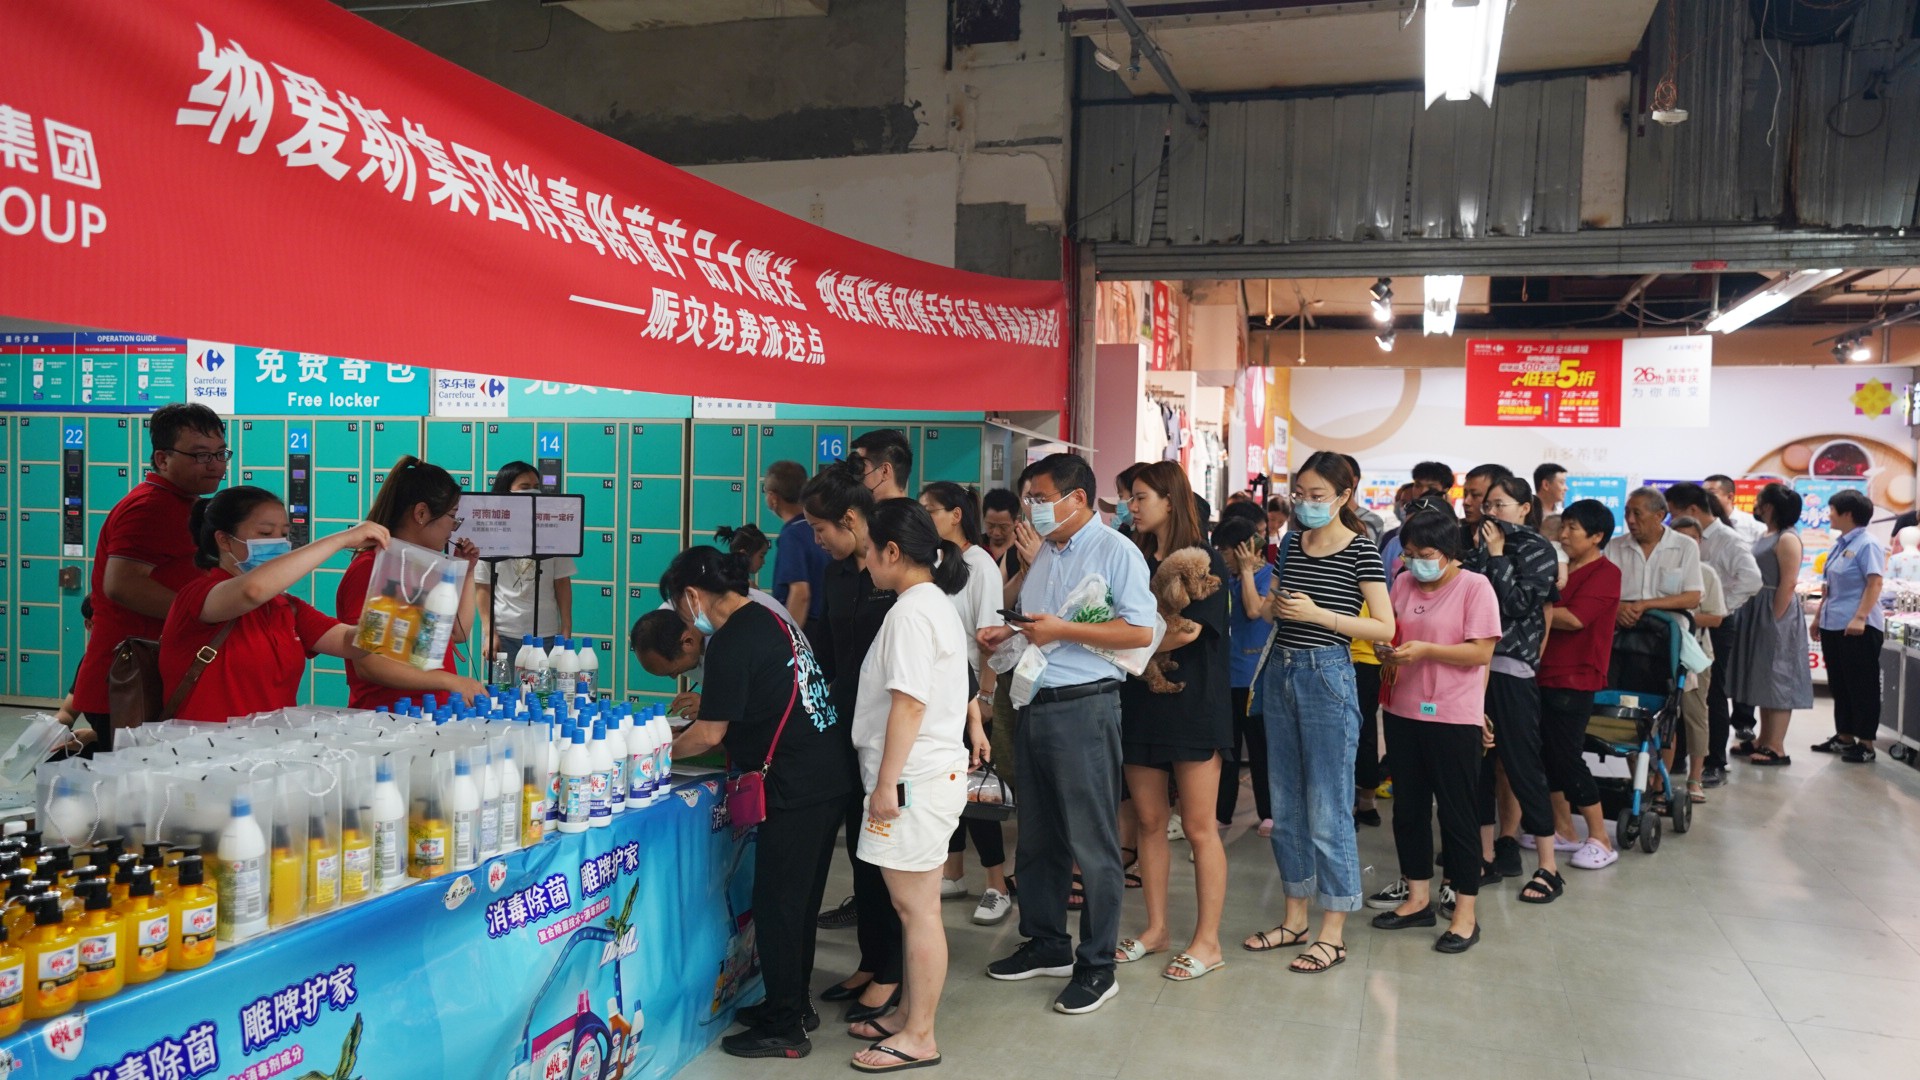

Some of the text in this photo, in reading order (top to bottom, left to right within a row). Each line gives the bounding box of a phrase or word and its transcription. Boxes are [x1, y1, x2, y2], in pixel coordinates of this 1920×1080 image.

[176, 22, 807, 311] 纳爱斯集团消毒除菌产品大赠送
[97, 335, 134, 343] OPERATION
[193, 376, 227, 385] Carrefour
[438, 378, 476, 389] 家乐福
[193, 386, 227, 397] 家乐福
[438, 390, 475, 399] Carrefour
[287, 391, 381, 408] Free locker
[635, 426, 643, 434] 19
[733, 427, 742, 435] 01
[764, 428, 773, 436] 07
[65, 429, 83, 444] 22
[290, 432, 308, 448] 21
[540, 435, 560, 452] 14
[820, 438, 843, 457] 16
[472, 509, 511, 520] 河南加油
[632, 535, 641, 543] 21
[602, 588, 611, 596] 16
[631, 589, 640, 597] 22
[580, 843, 640, 896] 雕牌护家
[488, 876, 569, 934] 消毒除菌
[242, 964, 357, 1047] 雕牌护家
